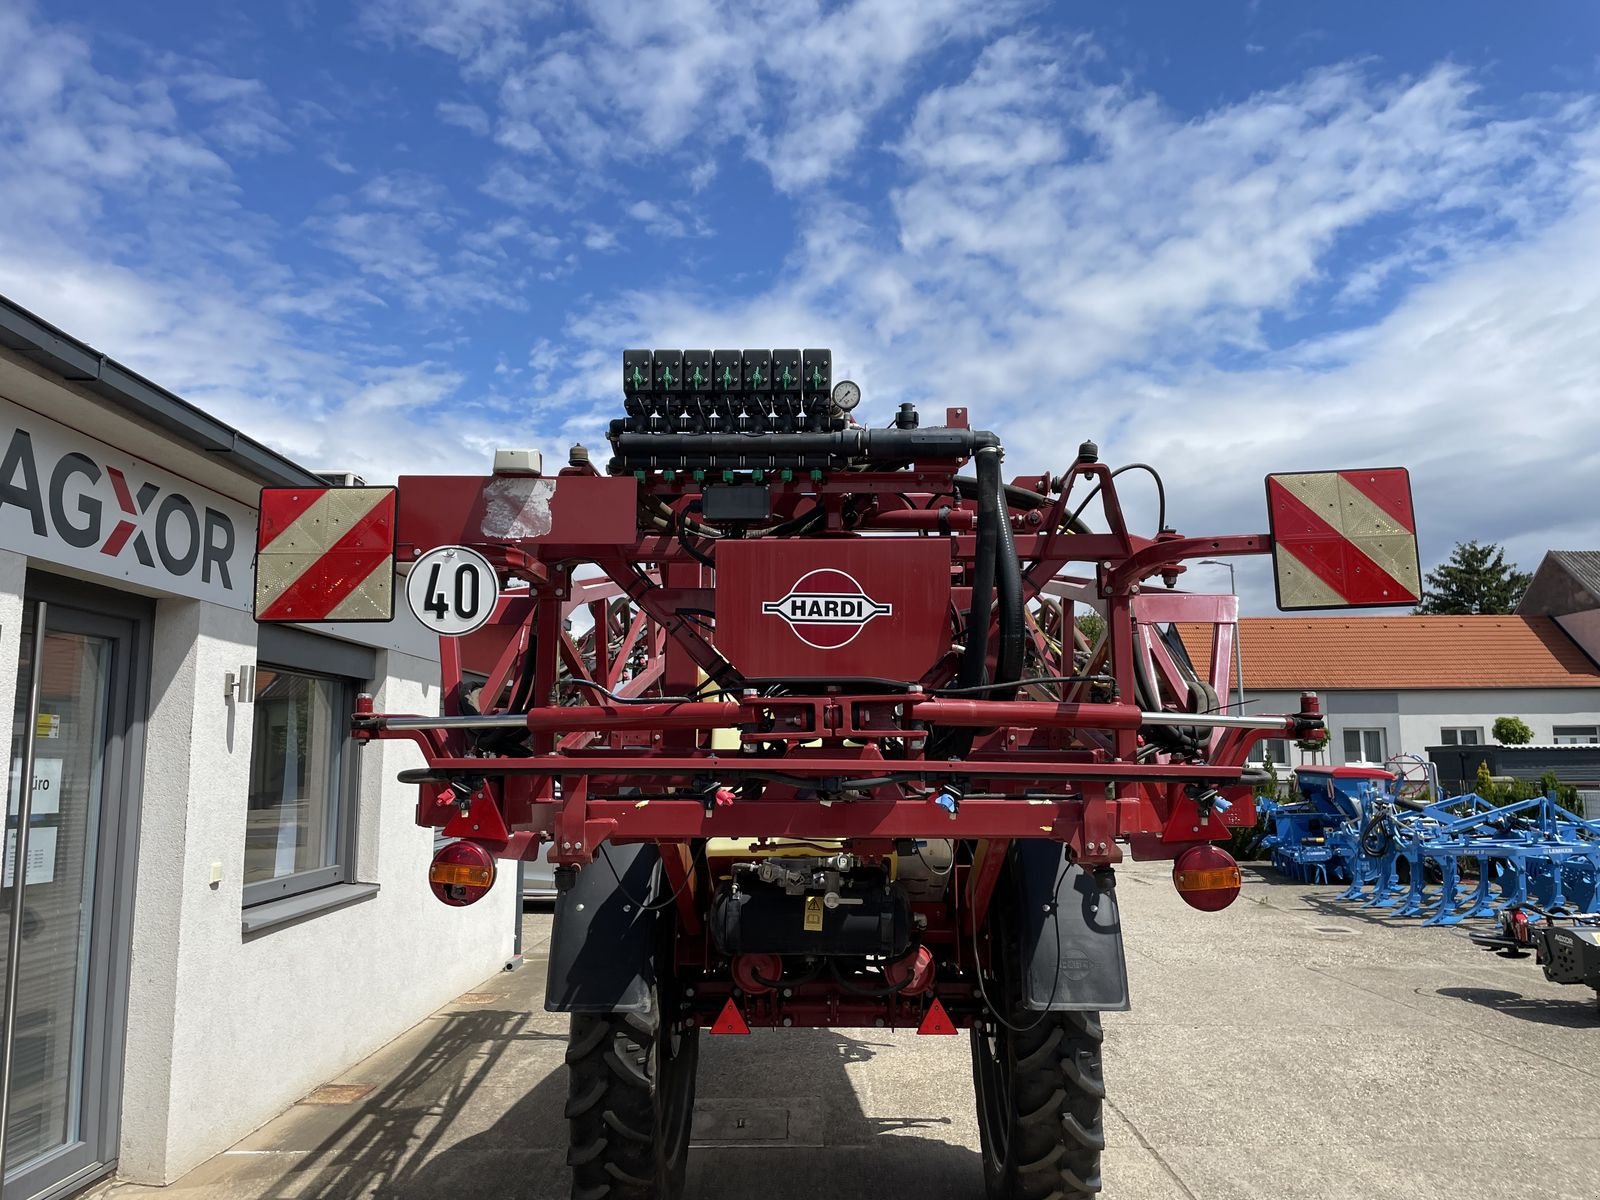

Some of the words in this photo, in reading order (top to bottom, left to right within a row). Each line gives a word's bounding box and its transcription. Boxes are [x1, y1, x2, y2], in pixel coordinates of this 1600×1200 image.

[0, 428, 235, 590] AGXOR
[424, 563, 480, 619] 40
[791, 600, 863, 617] HARDI
[31, 775, 50, 791] üro
